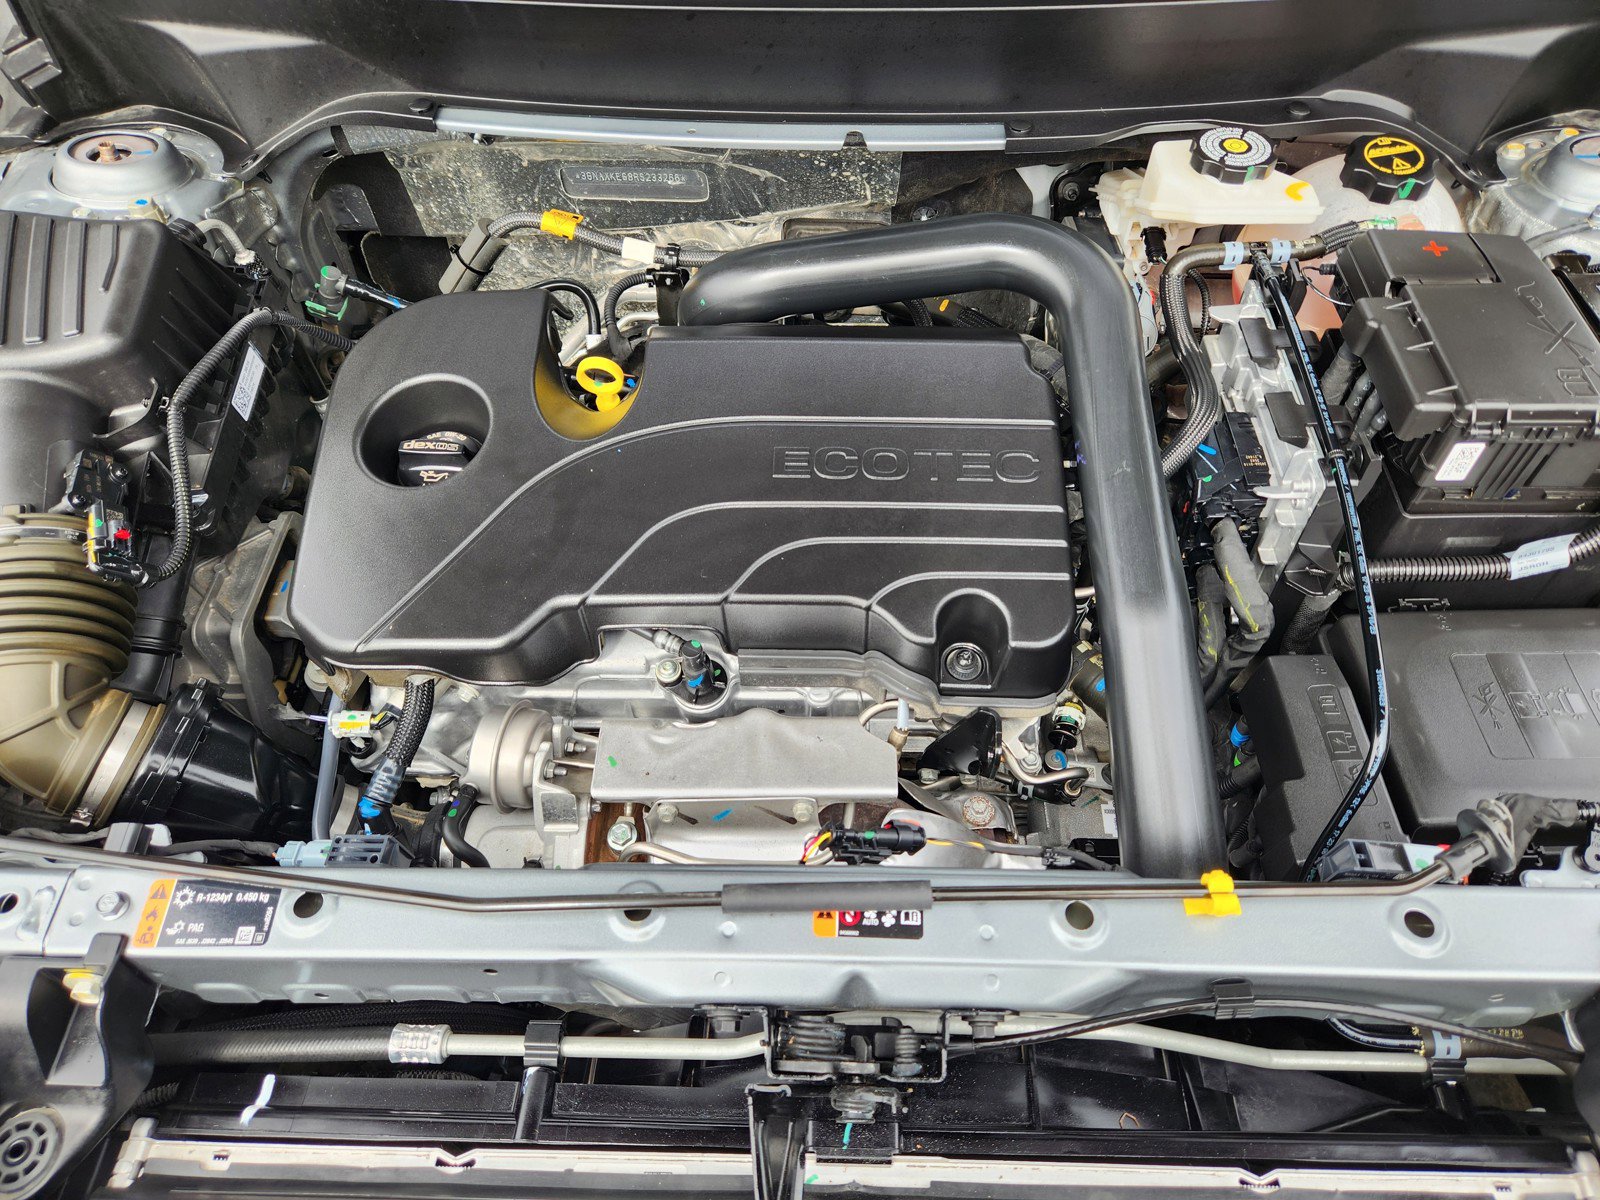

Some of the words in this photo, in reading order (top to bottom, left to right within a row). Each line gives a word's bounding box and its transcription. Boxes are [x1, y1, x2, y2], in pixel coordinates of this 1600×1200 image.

[402, 440, 459, 451] dexos
[772, 446, 1040, 483] ECOTEC
[197, 893, 233, 904] R-1234yf
[236, 892, 259, 903] 0.450
[259, 892, 270, 904] kg
[187, 923, 204, 932] PAG
[862, 918, 879, 926] AUTO
